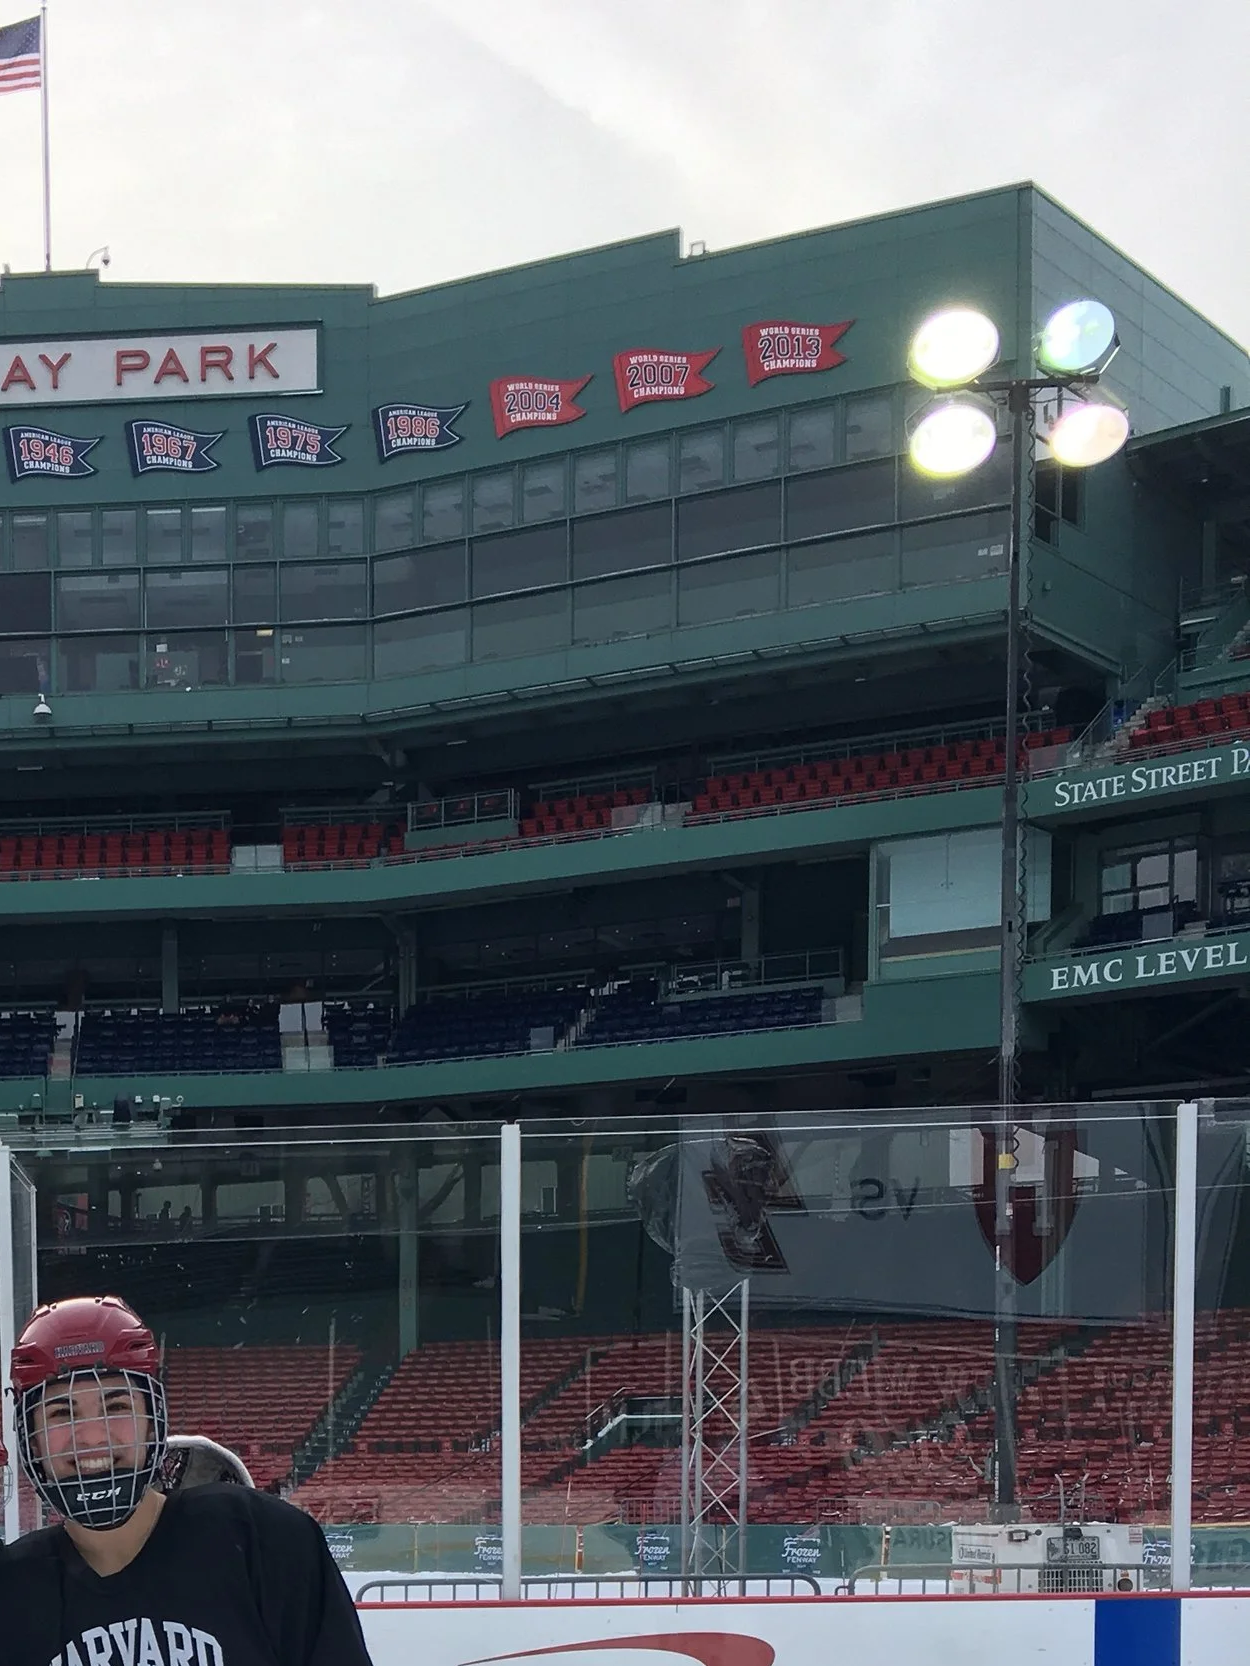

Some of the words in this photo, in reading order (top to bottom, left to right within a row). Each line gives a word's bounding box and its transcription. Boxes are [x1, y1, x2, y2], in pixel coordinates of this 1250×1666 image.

[759, 326, 789, 336] WORLD
[790, 326, 820, 336] SERIES
[758, 334, 822, 362] 2013
[114, 341, 280, 387] PARK
[629, 354, 658, 364] WORLD
[659, 355, 687, 364] SERIES
[763, 358, 817, 371] CHAMPIONS
[626, 362, 691, 389] 2007
[506, 382, 533, 391] WORLD
[534, 383, 560, 391] SERIES
[633, 385, 686, 398] CHAMPIONS
[504, 389, 562, 415] 2004
[388, 409, 416, 418] AMERICAN
[510, 412, 557, 423] CHAMPIONS
[266, 420, 296, 429] AMERICAN
[387, 415, 441, 440] 1986
[20, 432, 49, 442] AMERICAN
[142, 427, 172, 437] AMERICAN
[141, 433, 197, 461] 1967
[266, 426, 322, 455] 1975
[391, 438, 436, 448] CHAMPIONS
[19, 439, 74, 466] 1946
[269, 448, 317, 462] CHAMPIONS
[23, 461, 70, 474] CHAMPIONS
[146, 455, 193, 468] CHAMPIONS
[1054, 774, 1126, 807] STATE
[1131, 756, 1223, 794] STREET
[1050, 958, 1123, 991] EMC
[1135, 942, 1248, 979] LEVEL
[76, 1485, 122, 1502] CCM
[782, 1540, 822, 1558] Frozen
[786, 1556, 818, 1564] FENWAY
